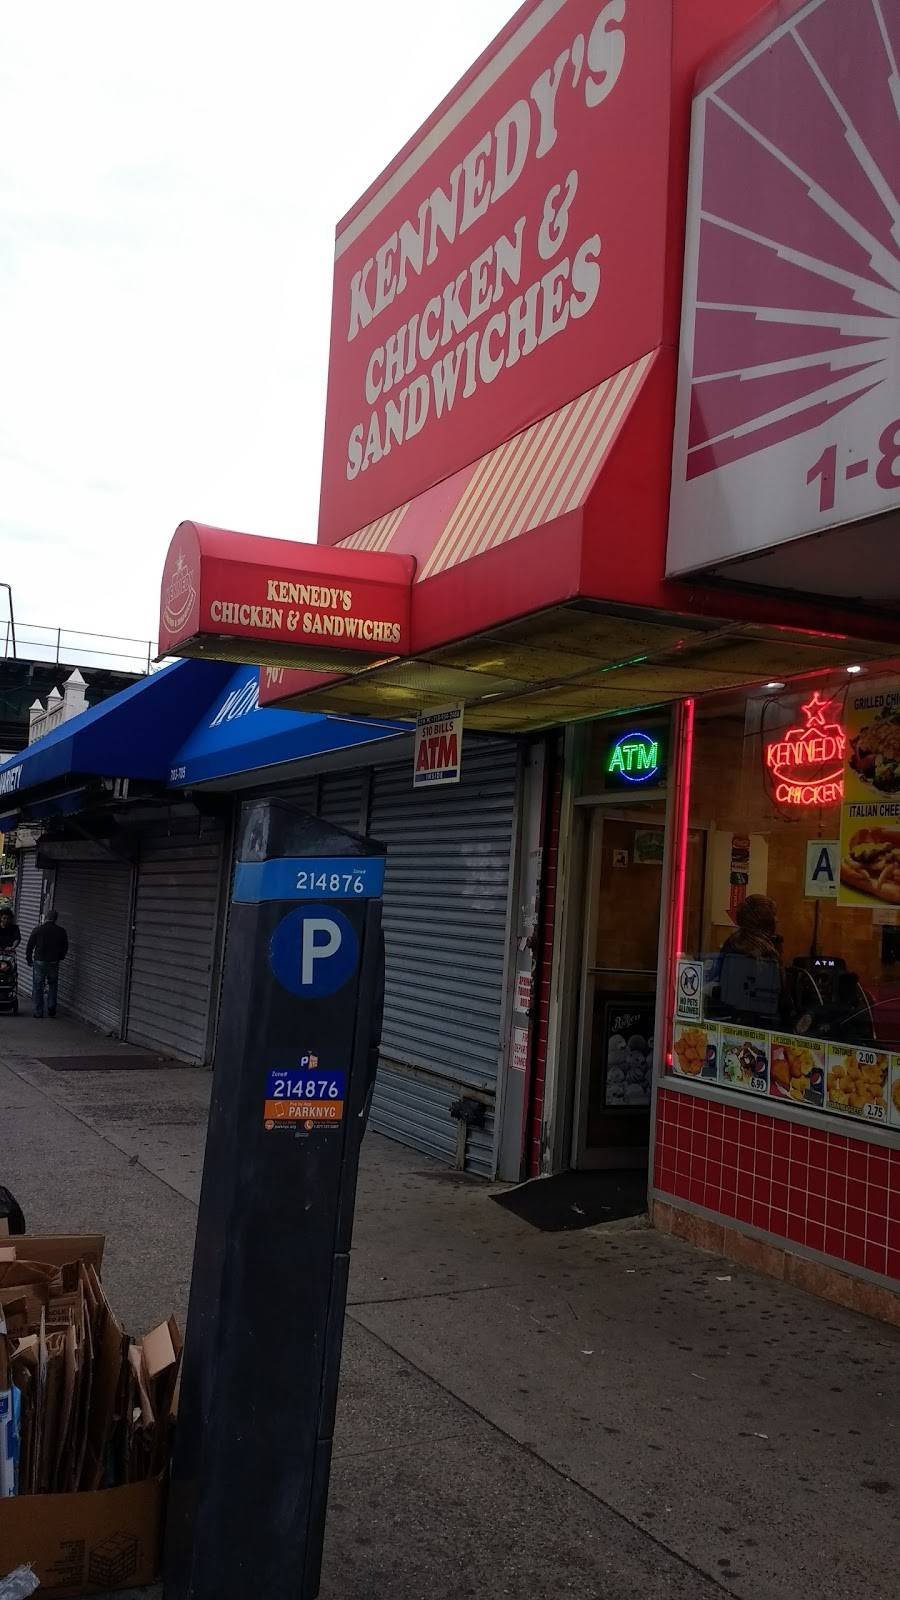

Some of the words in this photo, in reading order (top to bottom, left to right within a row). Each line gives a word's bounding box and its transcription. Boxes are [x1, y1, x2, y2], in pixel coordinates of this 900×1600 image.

[347, 0, 626, 342] KENNEDY'S
[365, 215, 527, 404] CHICKEN
[538, 169, 579, 261] &
[346, 233, 601, 480] SANDWICHES
[266, 579, 353, 612] KENNEDY'S
[210, 600, 284, 630] CHICKEN
[286, 610, 300, 632] &
[302, 612, 401, 644] SANDWICHES
[208, 675, 264, 728] WON
[854, 695, 884, 710] GRILLED
[886, 693, 900, 706] CHI
[434, 720, 454, 735] BILLS
[416, 733, 458, 772] ATM
[608, 741, 659, 772] ATM
[766, 735, 846, 767] KENNEDY
[775, 780, 845, 804] CHICKEN
[848, 805, 878, 817] ITALIAN
[811, 847, 834, 881] A
[296, 871, 364, 894] 214876
[302, 918, 342, 985] P
[814, 959, 835, 967] ATM
[678, 1004, 699, 1015] ALLOWED
[679, 996, 687, 1005] NO
[687, 997, 699, 1007] PETS
[859, 1052, 874, 1064] 2.00
[273, 1079, 339, 1098] 214876
[288, 1106, 336, 1118] PARKNYC
[867, 1105, 883, 1118] 2.75
